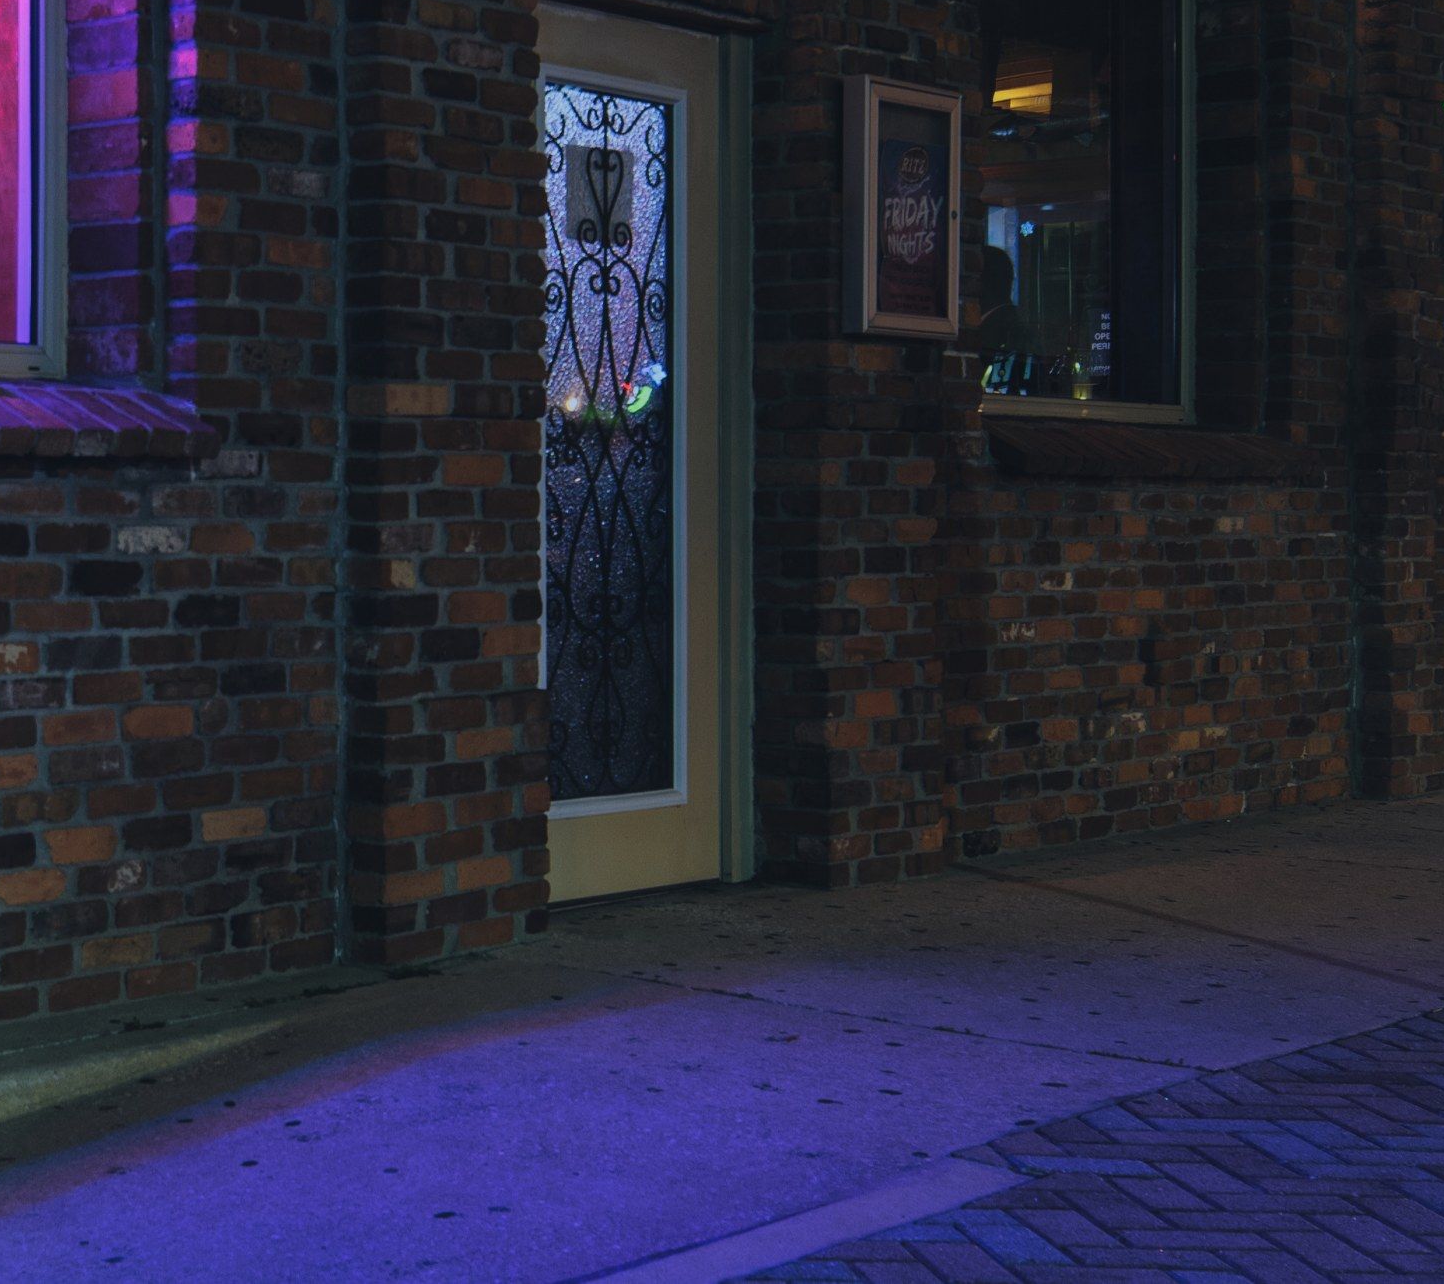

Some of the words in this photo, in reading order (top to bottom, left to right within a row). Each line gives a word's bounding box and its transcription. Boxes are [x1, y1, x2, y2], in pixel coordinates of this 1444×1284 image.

[900, 156, 927, 174] RITZ
[883, 195, 944, 231] FRIDAY
[887, 230, 937, 256] NIGHTS
[1094, 332, 1111, 341] OPE
[1091, 342, 1111, 351] PER
